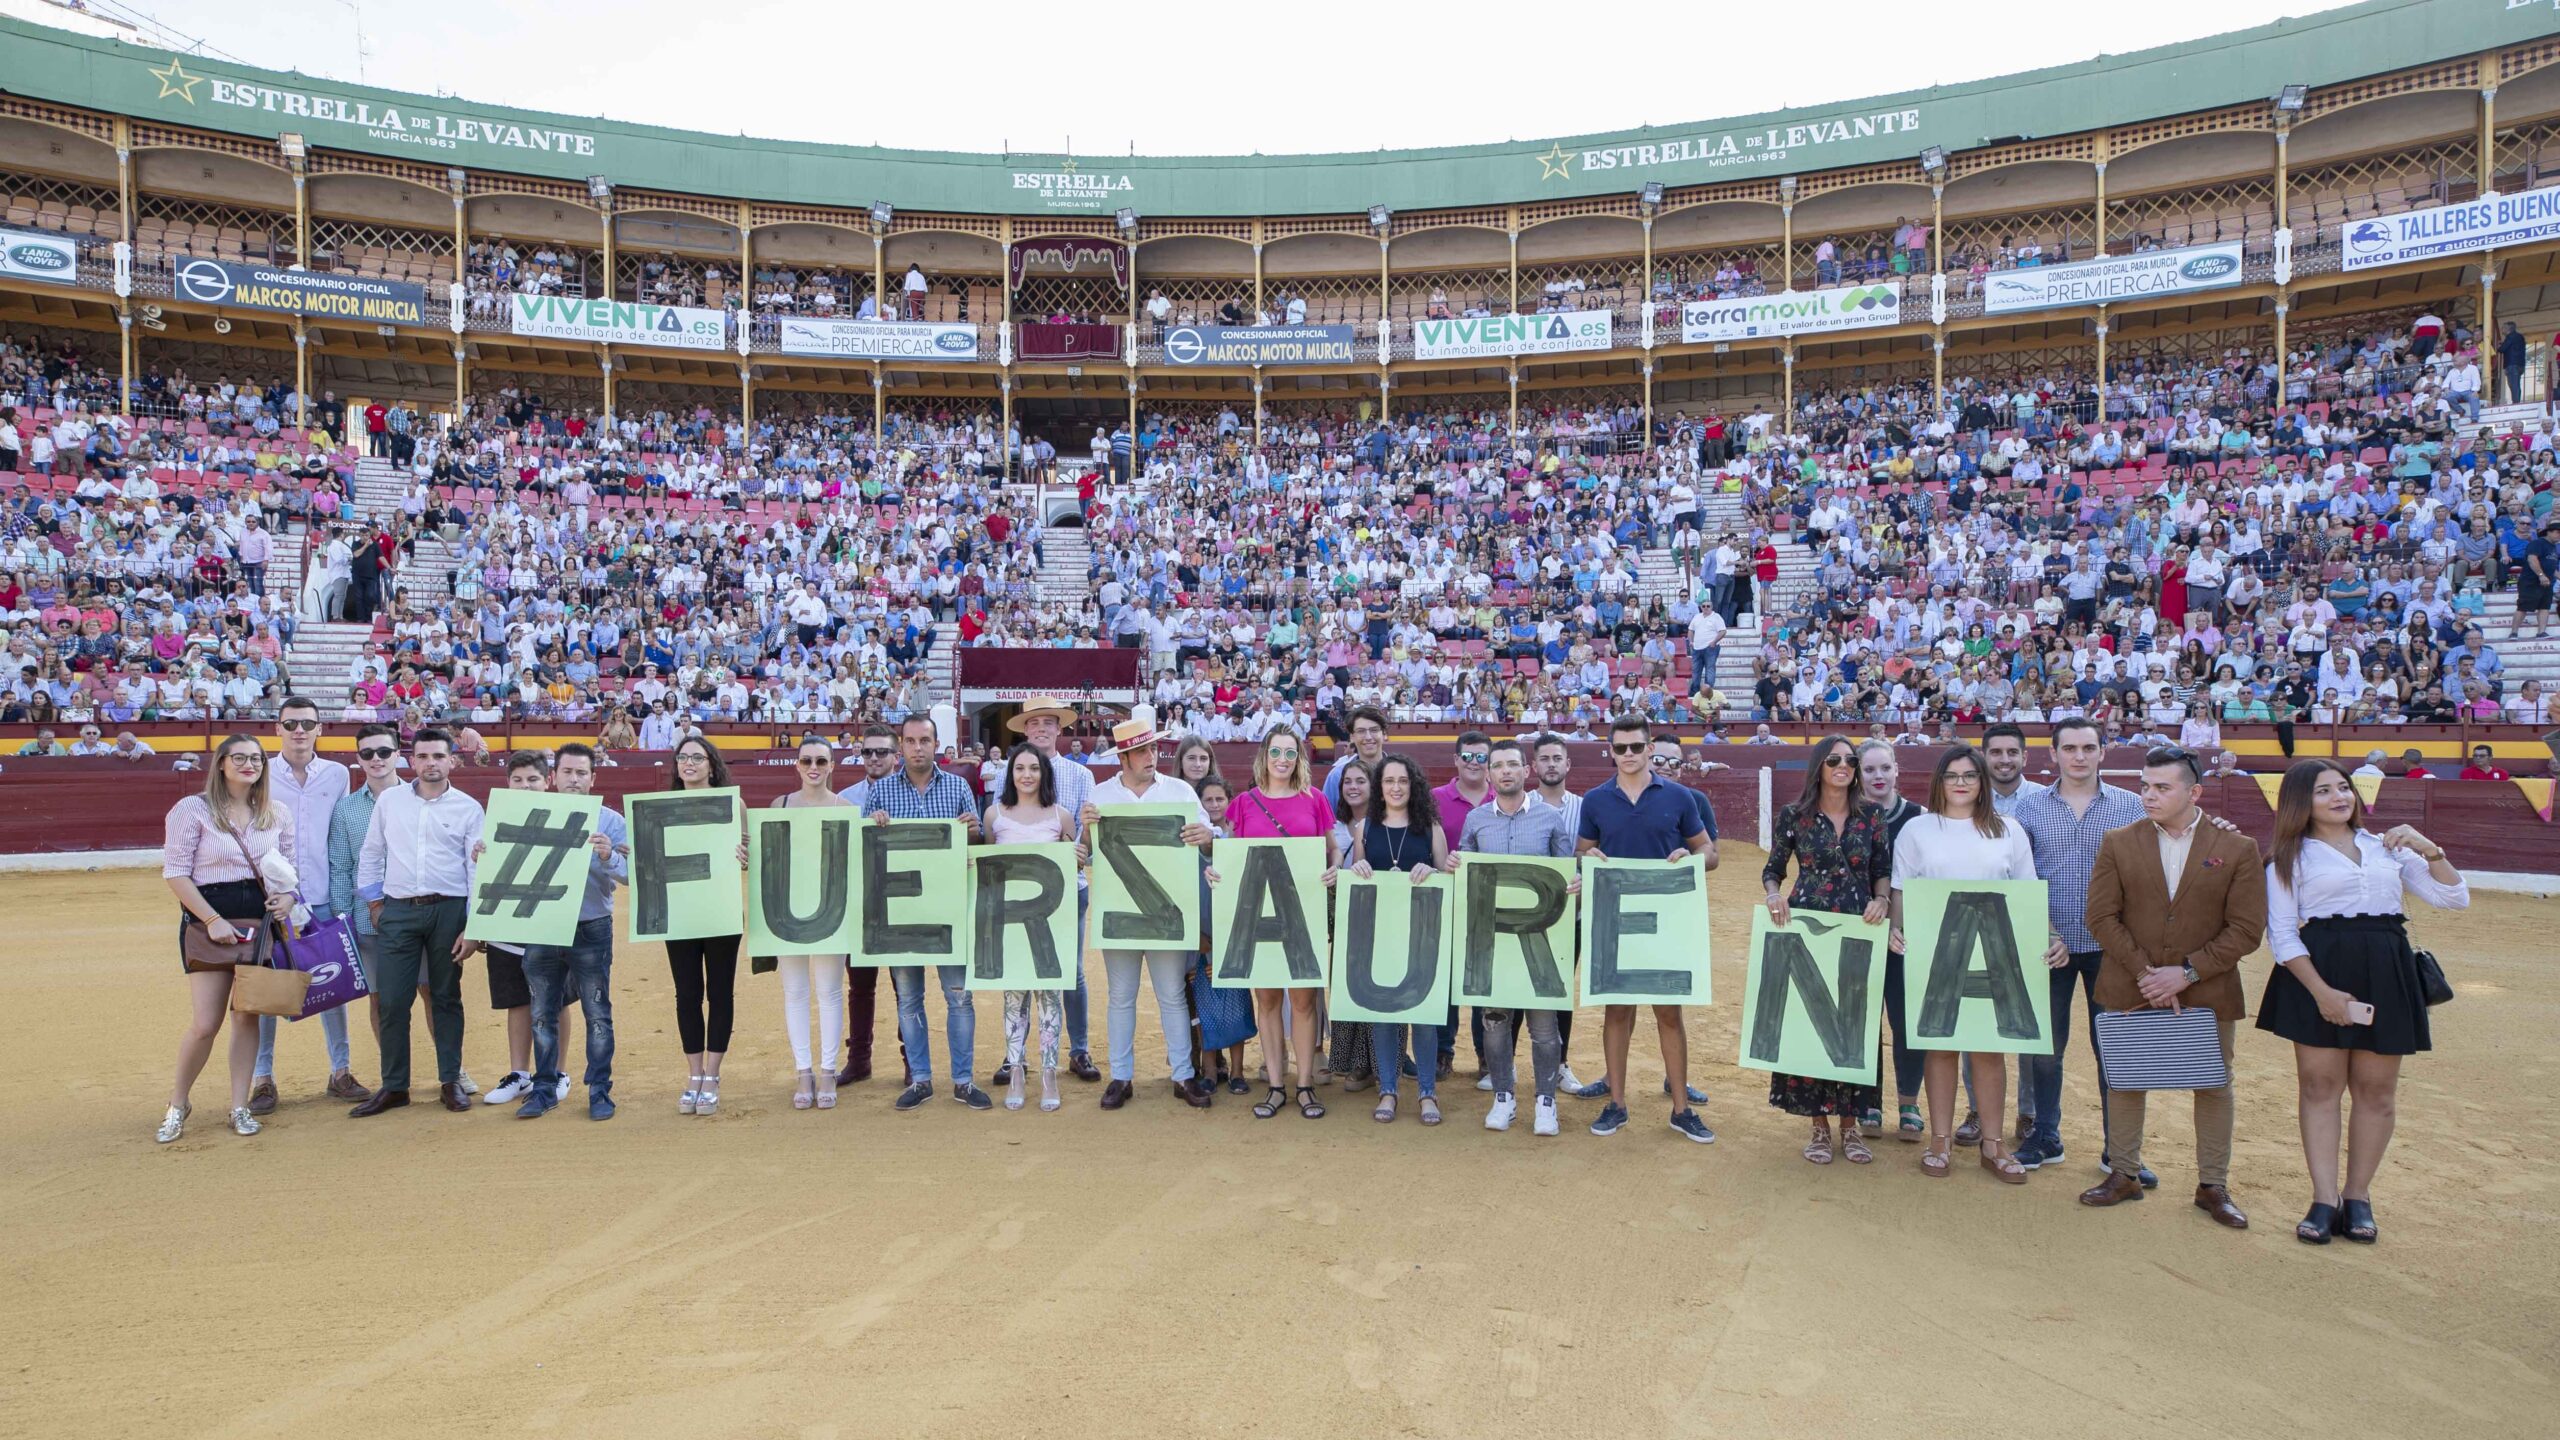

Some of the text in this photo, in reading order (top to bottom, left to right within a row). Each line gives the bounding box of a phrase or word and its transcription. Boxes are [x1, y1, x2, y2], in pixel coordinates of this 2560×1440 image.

[211, 79, 595, 156] ESTRELLA DE LEVANTE
[1581, 108, 1919, 171] ESTRELLA DE LEVANTE
[1012, 173, 1134, 190] ESTRELLA
[1040, 189, 1108, 198] DE LEVANTE
[2398, 203, 2492, 242] TALLERES
[2401, 223, 2560, 258] Taller autorizado IVE
[21, 247, 52, 258] LAND
[2348, 252, 2394, 267] IVECO
[25, 256, 63, 268] ROVER
[2048, 256, 2178, 282] CONCESIONARIO OFICIAL PARA MURCIA
[2191, 258, 2219, 270] LAND
[2193, 264, 2229, 276] ROVER
[253, 271, 391, 295] CONCESIONARIO OFICIAL
[2047, 271, 2178, 303] PREMIERCAR
[235, 284, 420, 322] MARCOS MOTOR MURCIA
[1685, 293, 1831, 327] terramovil
[1780, 313, 1897, 330] El valor de un gran Grupo
[518, 321, 721, 346] tu inmobiliaria de confianza
[832, 325, 932, 337] CONCESIONARIO OFICIAL PARA MURCIA
[942, 333, 963, 342] LAND
[1221, 329, 1328, 340] CONCESIONARIO OFICIAL
[831, 336, 933, 355] PREMIERCAR
[944, 340, 970, 349] ROVER
[1065, 334, 1075, 352] P
[1207, 342, 1351, 362] MARCOS MOTOR MURCIA
[1419, 337, 1608, 357] tu inmobiliaria de confianza
[995, 691, 1028, 700] SALIDA
[338, 931, 366, 991] Sprinter
